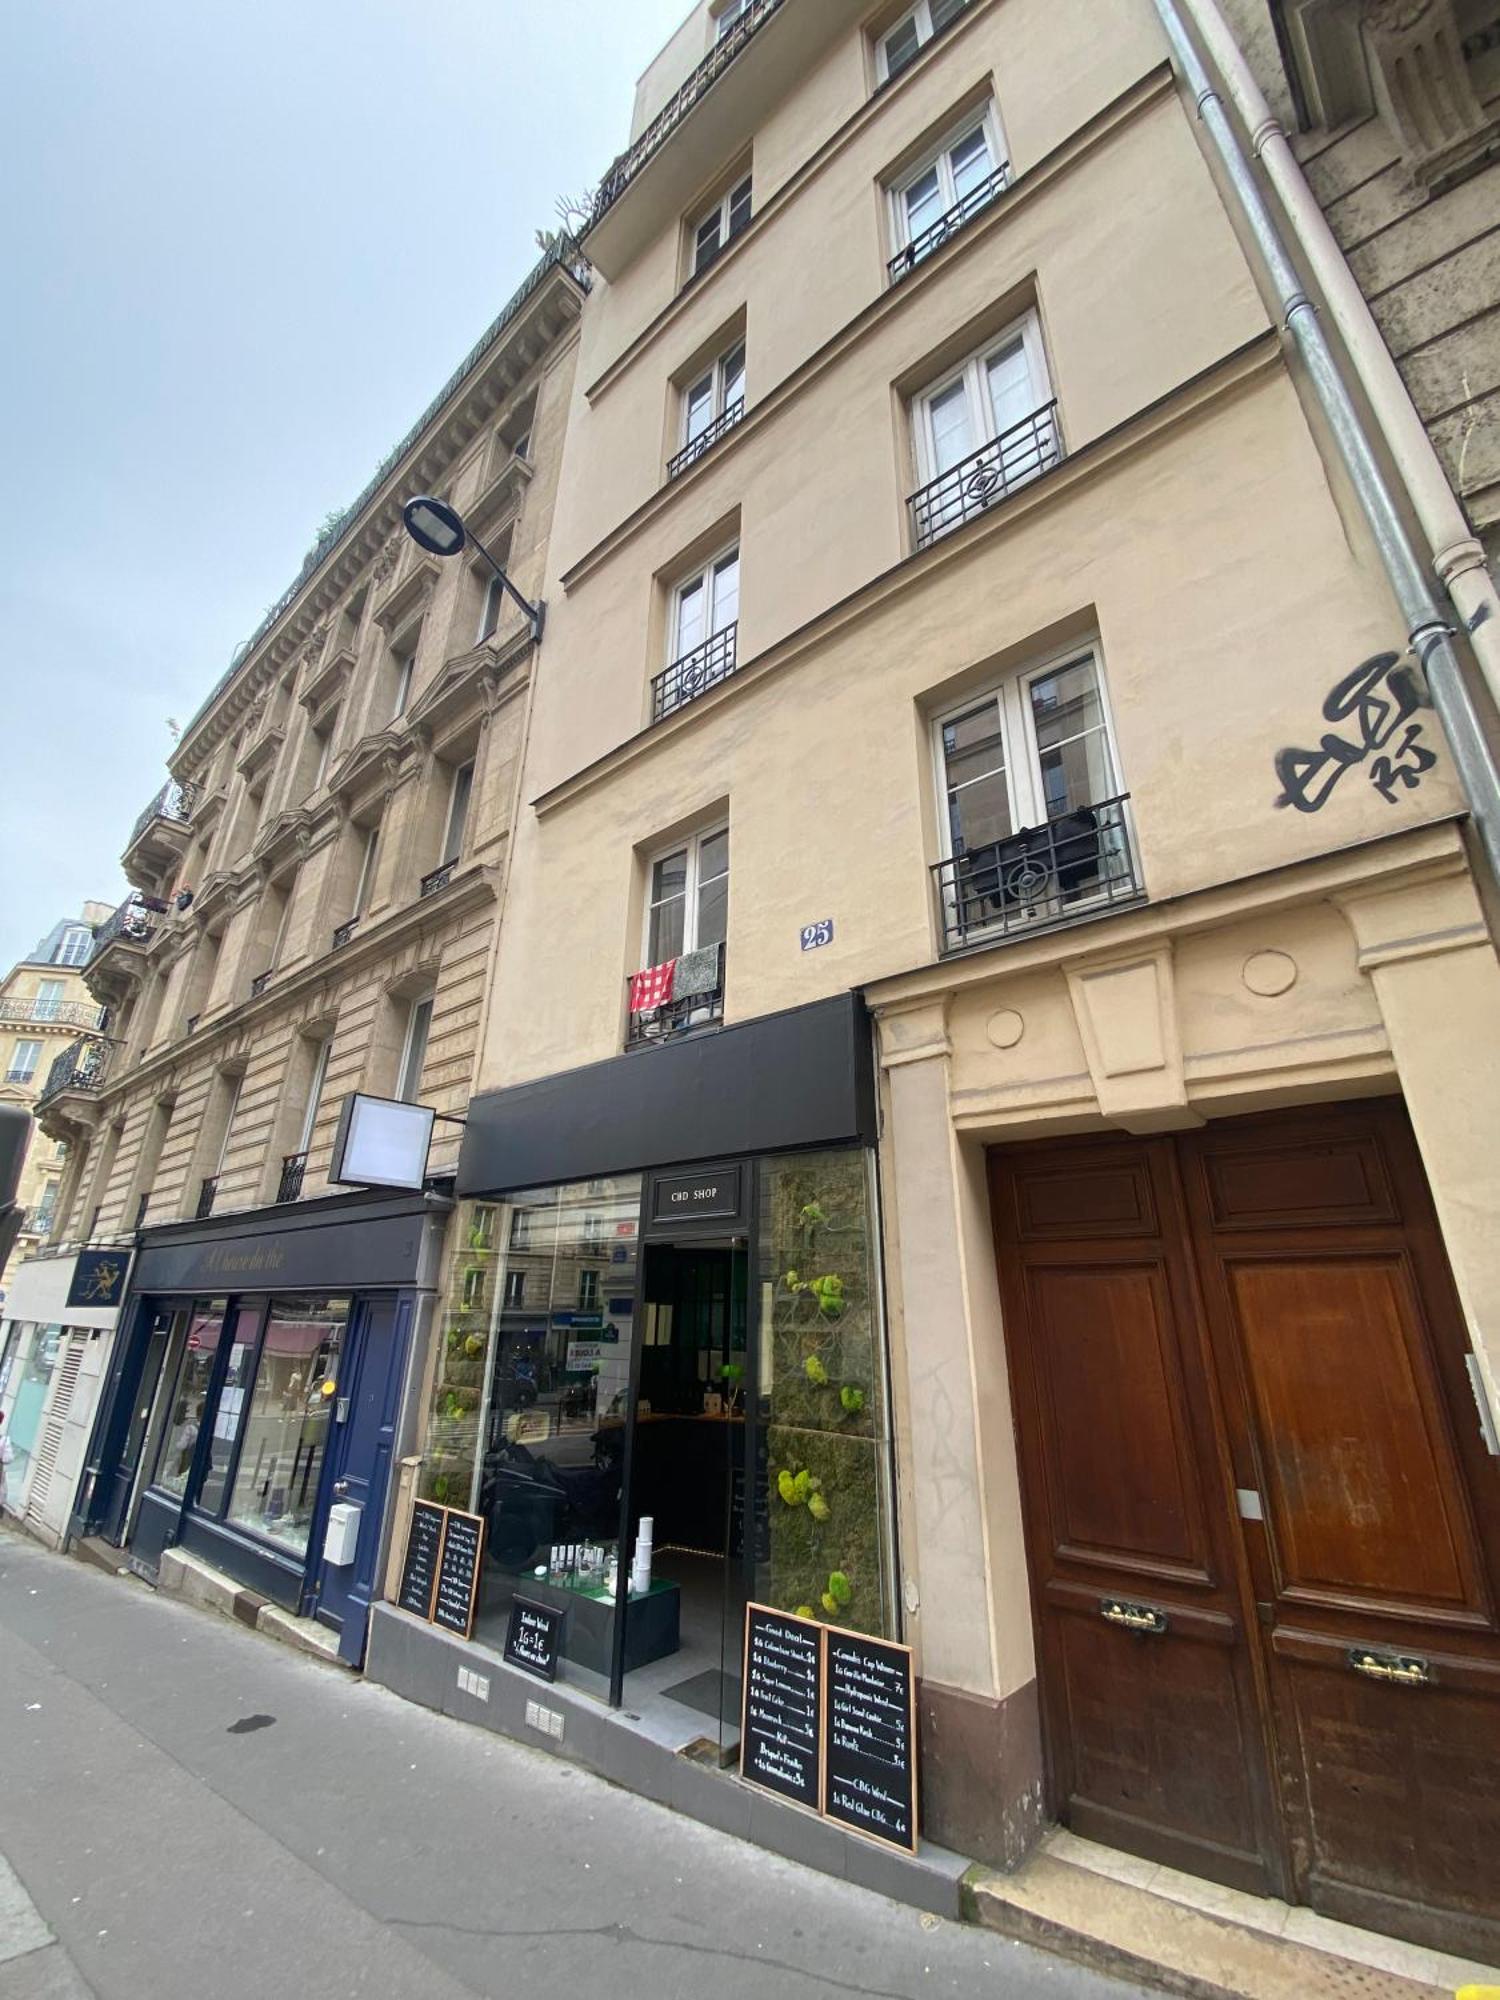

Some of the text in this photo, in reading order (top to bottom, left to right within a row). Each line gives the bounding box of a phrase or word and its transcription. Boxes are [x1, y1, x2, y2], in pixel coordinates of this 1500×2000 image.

[803, 920, 830, 951] 25
[671, 1186, 718, 1203] CBD SHOP
